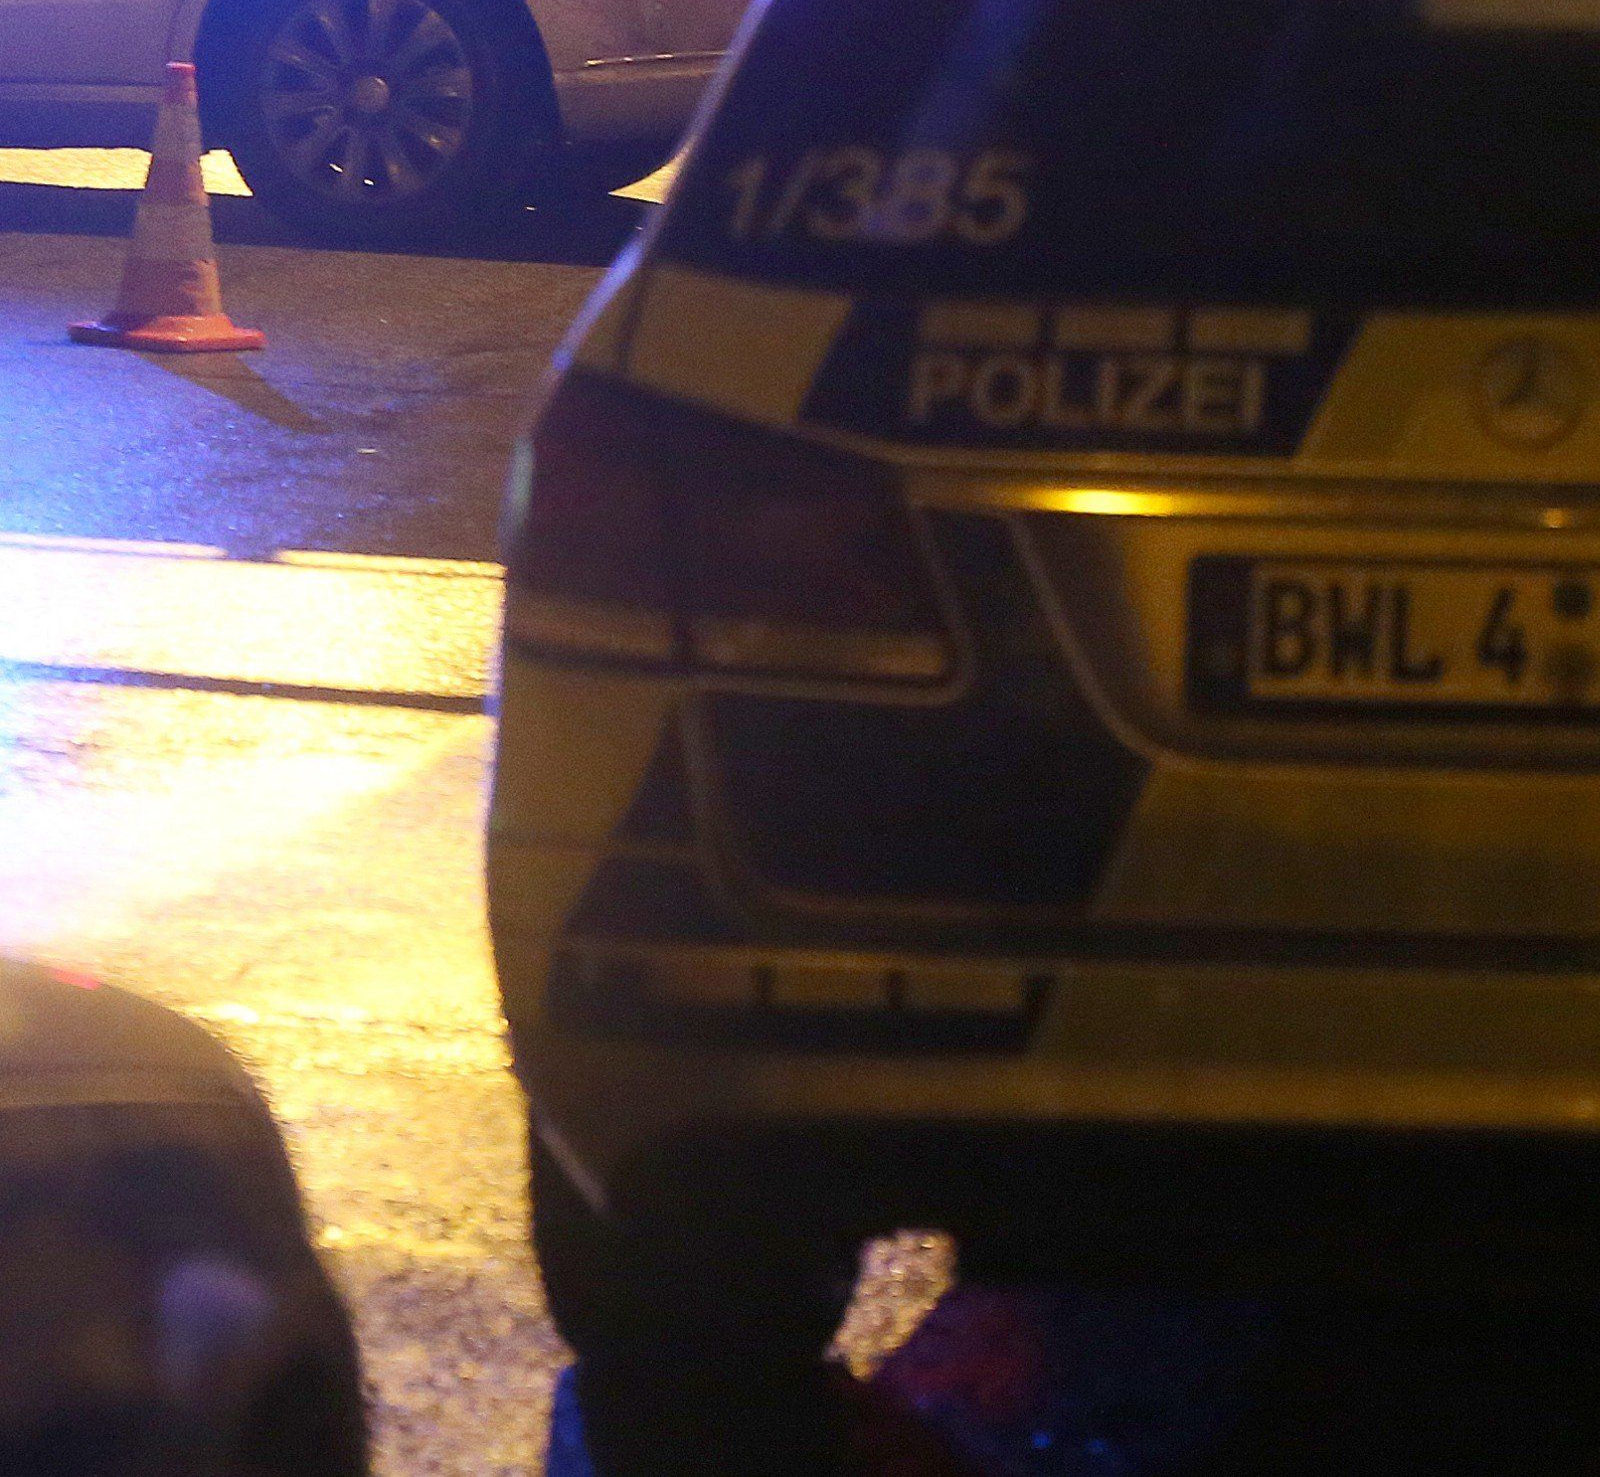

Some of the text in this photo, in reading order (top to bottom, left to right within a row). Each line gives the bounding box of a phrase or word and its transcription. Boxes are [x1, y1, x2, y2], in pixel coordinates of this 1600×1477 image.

[725, 144, 1030, 244] 1/385
[909, 350, 1267, 431] POLIZEI
[1262, 578, 1527, 686] BWL 4
